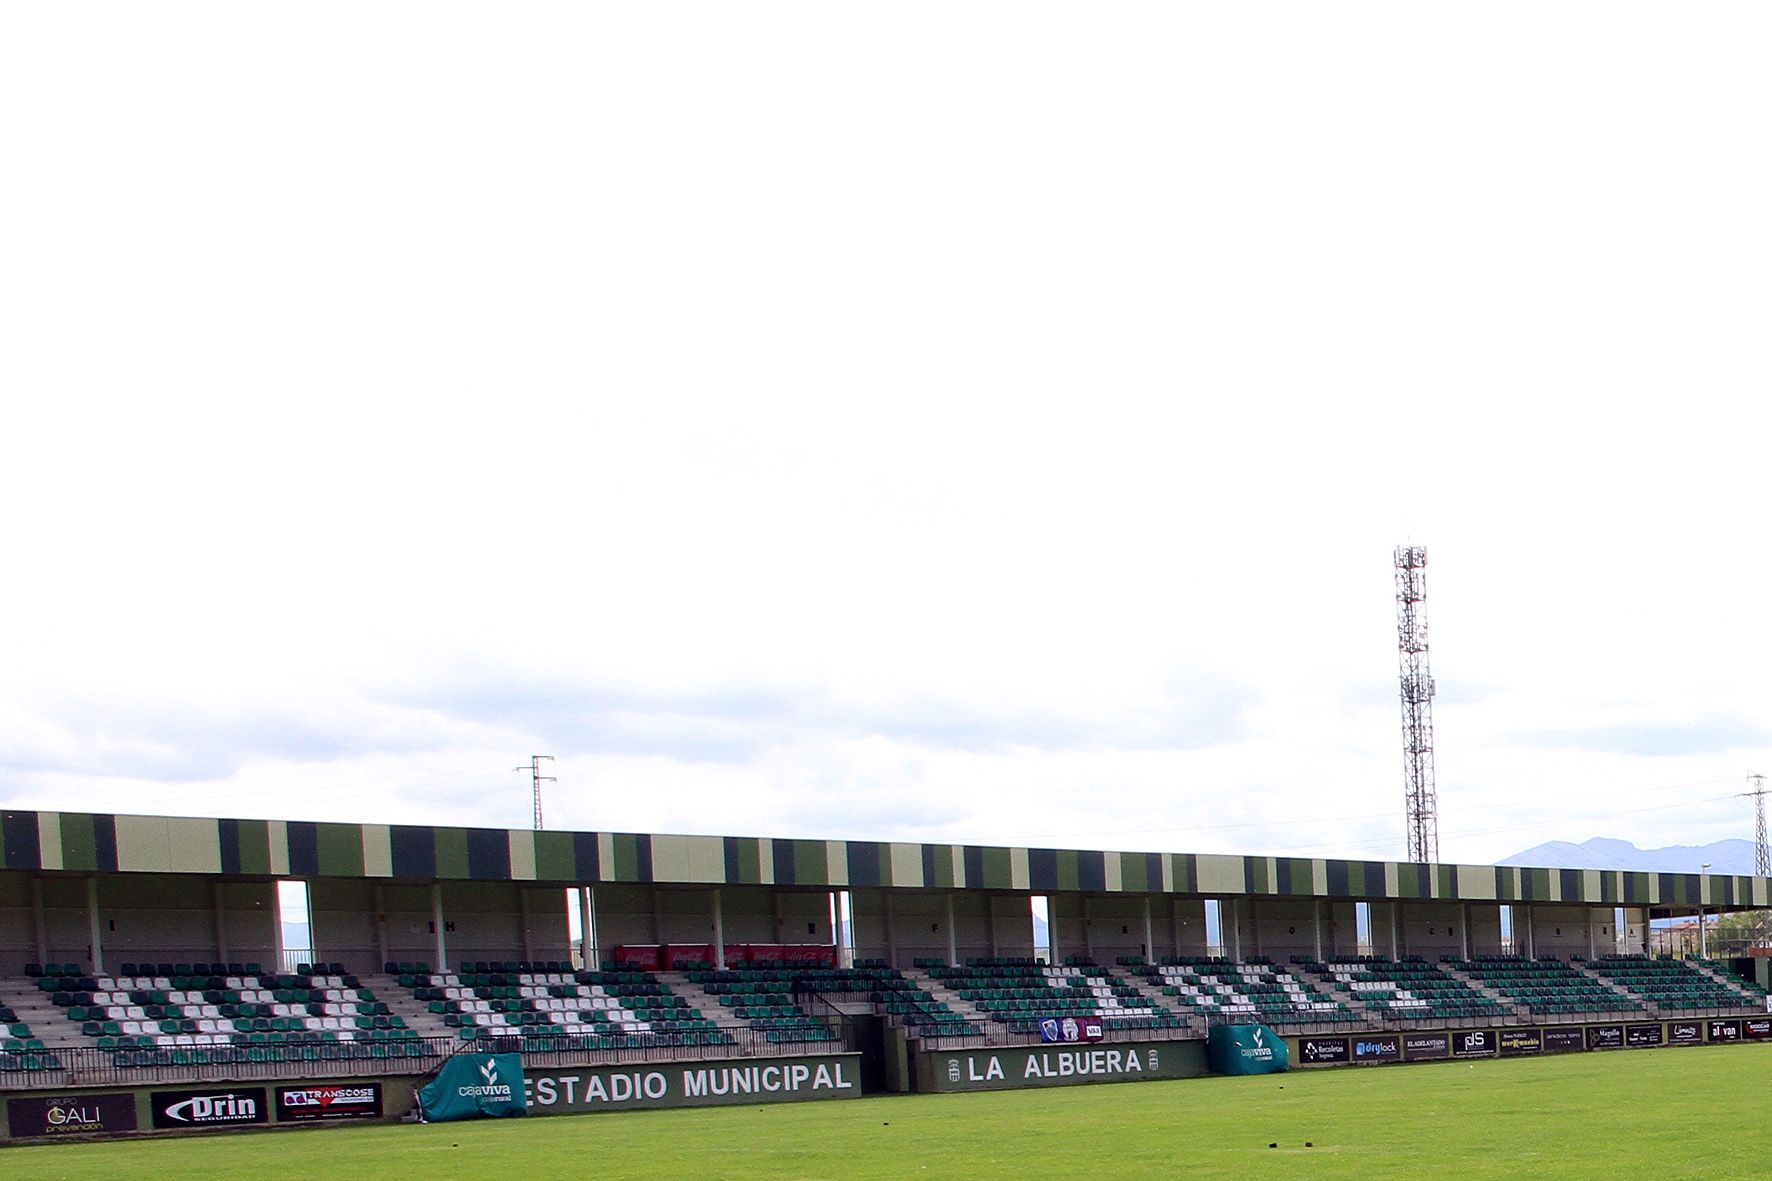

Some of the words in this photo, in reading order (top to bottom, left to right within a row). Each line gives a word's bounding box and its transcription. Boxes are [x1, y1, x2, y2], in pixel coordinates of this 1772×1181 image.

[1318, 1045, 1344, 1053] Recoletas
[1365, 1042, 1397, 1055] drylock
[968, 1056, 1005, 1081] LA
[1024, 1049, 1143, 1078] ALBUERA
[683, 1063, 852, 1097] MUNICIPAL
[458, 1084, 511, 1098] cajaviva
[46, 1097, 77, 1106] GRUPO
[192, 1094, 256, 1118] Drin
[47, 1106, 101, 1125] GALI
